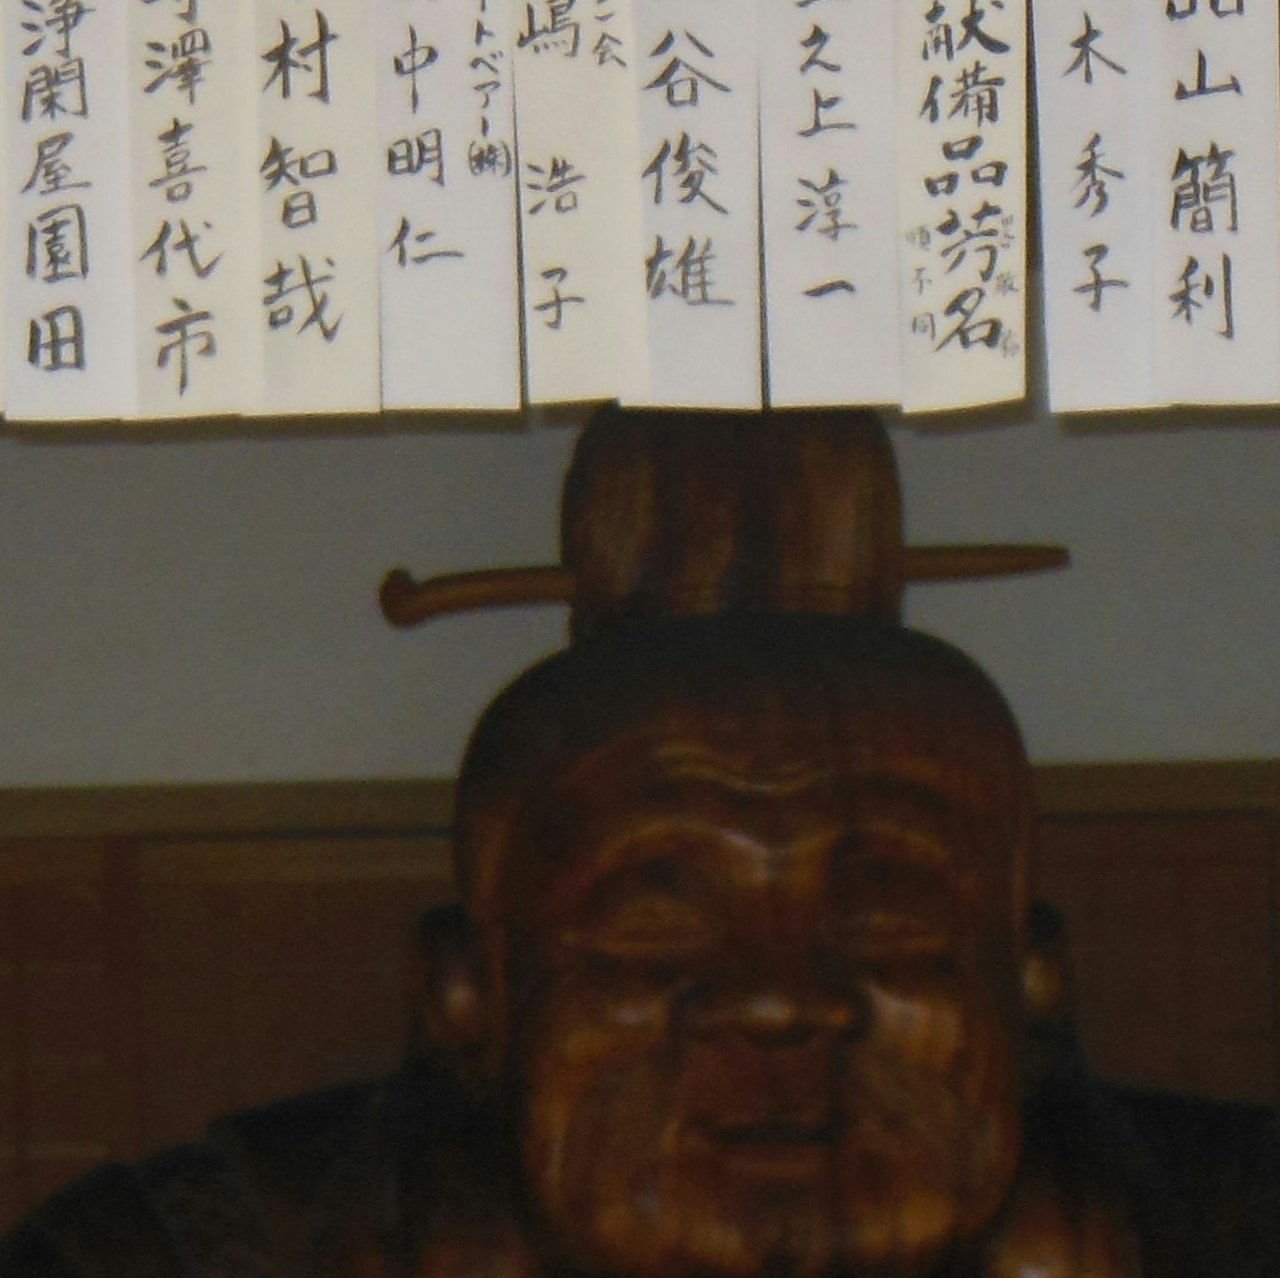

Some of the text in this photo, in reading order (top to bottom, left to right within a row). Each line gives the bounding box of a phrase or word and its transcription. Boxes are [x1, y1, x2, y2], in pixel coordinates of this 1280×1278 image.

[140, 0, 222, 397] 澤喜代市
[260, 9, 341, 344] 村智哉
[387, 25, 465, 269] 中明仁
[642, 30, 735, 308] 谷俊雄
[1065, 12, 1130, 314] 木秀子
